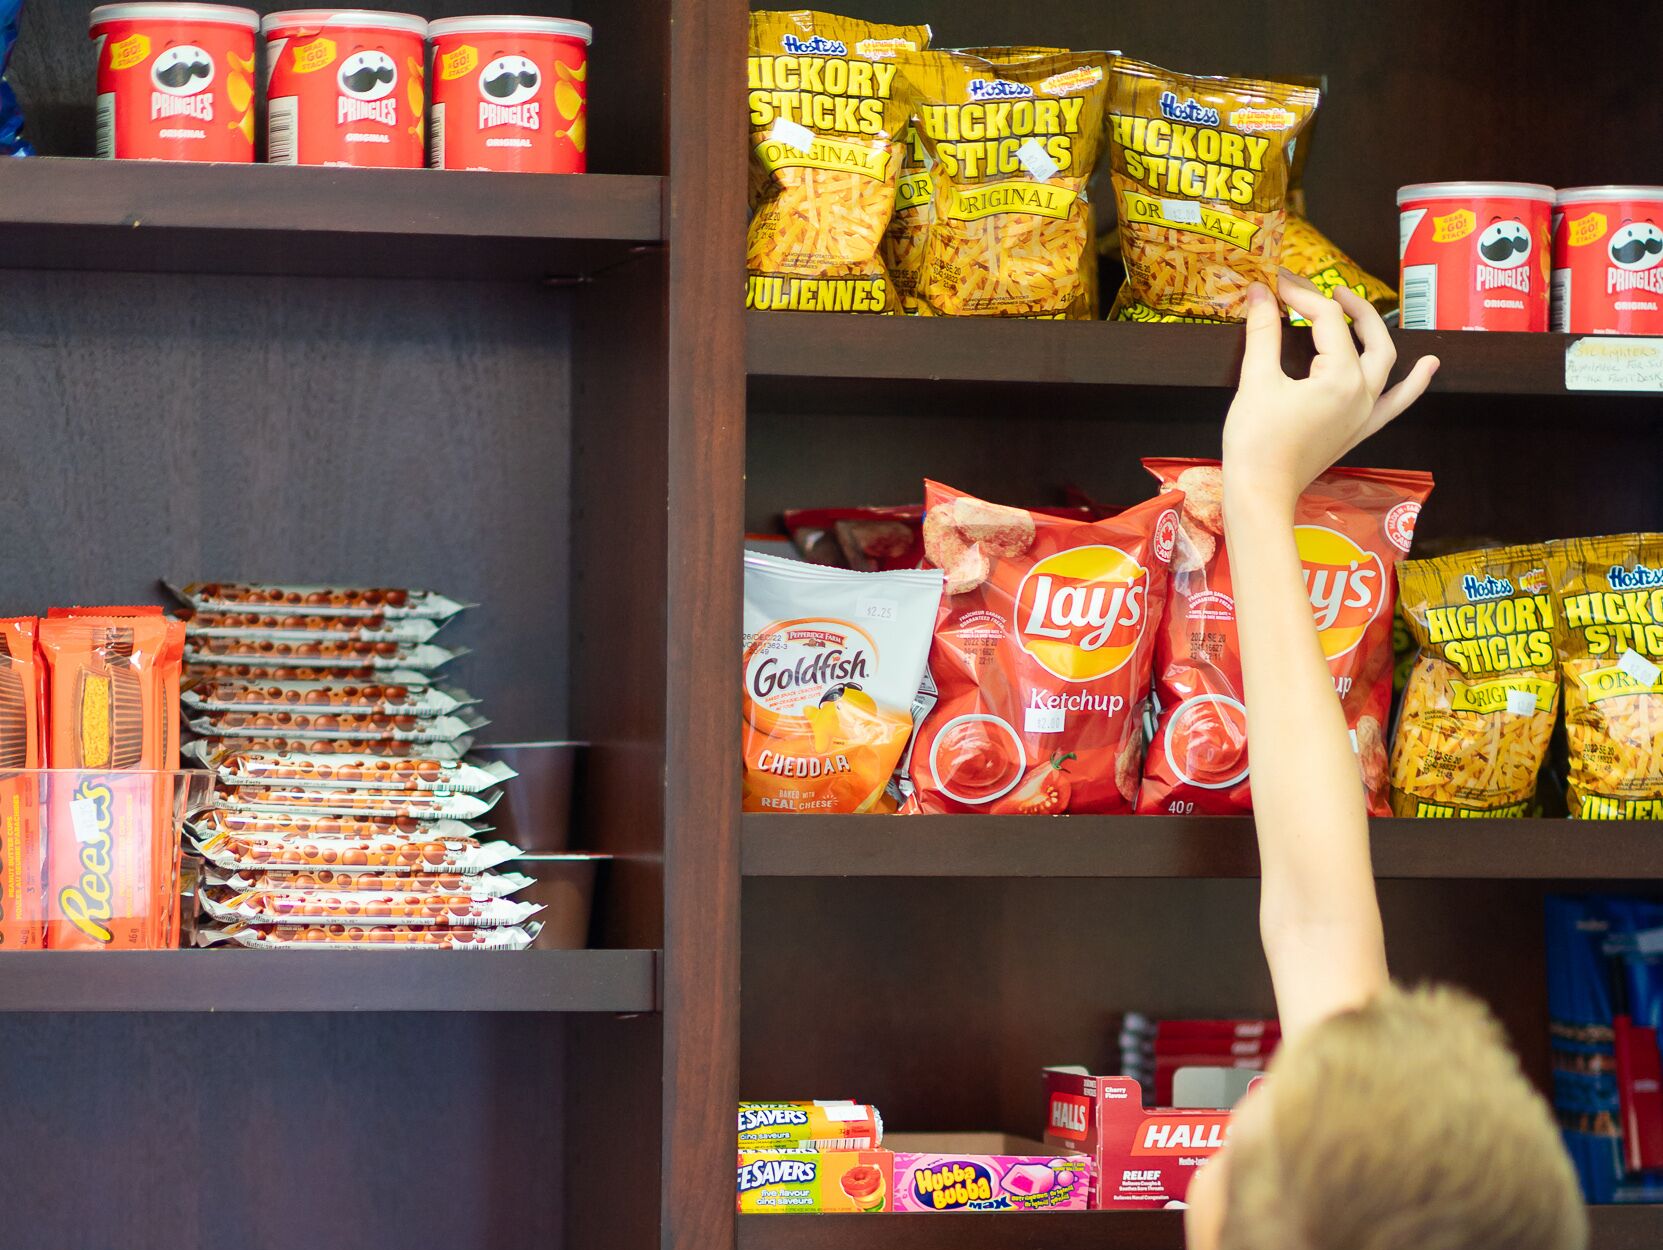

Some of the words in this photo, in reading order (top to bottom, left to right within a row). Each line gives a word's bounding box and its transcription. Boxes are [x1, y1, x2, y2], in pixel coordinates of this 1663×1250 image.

[784, 36, 845, 54] Hostess
[971, 80, 1031, 97] Hostess
[152, 92, 213, 121] PRINGLES
[337, 96, 397, 126] PRINGLES
[479, 102, 540, 130] PRINGLES
[749, 90, 885, 134] STICKS
[922, 98, 1083, 140] HICKORY
[1161, 92, 1218, 124] Hostess
[345, 133, 390, 143] ORIGINAL
[486, 139, 532, 148] ORIGINAL
[1109, 115, 1269, 171] HICKORY
[936, 136, 1071, 177] STICS
[1125, 149, 1255, 204] STICKS
[960, 188, 1058, 214] ORIGINAL
[1135, 199, 1239, 239] ORNAL
[1476, 265, 1530, 294] PRINGLES
[1608, 267, 1663, 294] PRINGLES
[1484, 300, 1524, 309] ORIGINAL
[1614, 301, 1658, 311] ORIGINAL
[1465, 575, 1513, 600] Hostess
[866, 604, 893, 618] $2.25
[1024, 575, 1144, 652] Lay's
[1426, 595, 1554, 644] HICKORY
[1564, 590, 1663, 628] HICKO
[790, 631, 824, 639] PEPPERIDGE
[825, 633, 841, 642] FARM
[1585, 623, 1663, 656] STIC
[1444, 631, 1552, 674] STICKS
[753, 649, 866, 697] Goldfish
[1031, 688, 1123, 717] Ketchup
[758, 749, 851, 777] CHEDDAR
[761, 797, 796, 809] REAL
[799, 800, 833, 809] CHEESE
[779, 789, 799, 799] BAKED
[738, 1110, 808, 1131] ESAVERS
[1052, 1101, 1086, 1132] HALLS
[760, 1132, 790, 1140] saveurs
[915, 1164, 976, 1194] Hubba
[1123, 1171, 1161, 1180] RELIEF
[761, 1189, 777, 1197] five
[779, 1189, 810, 1197] flavour
[932, 1177, 991, 1209] Bubba
